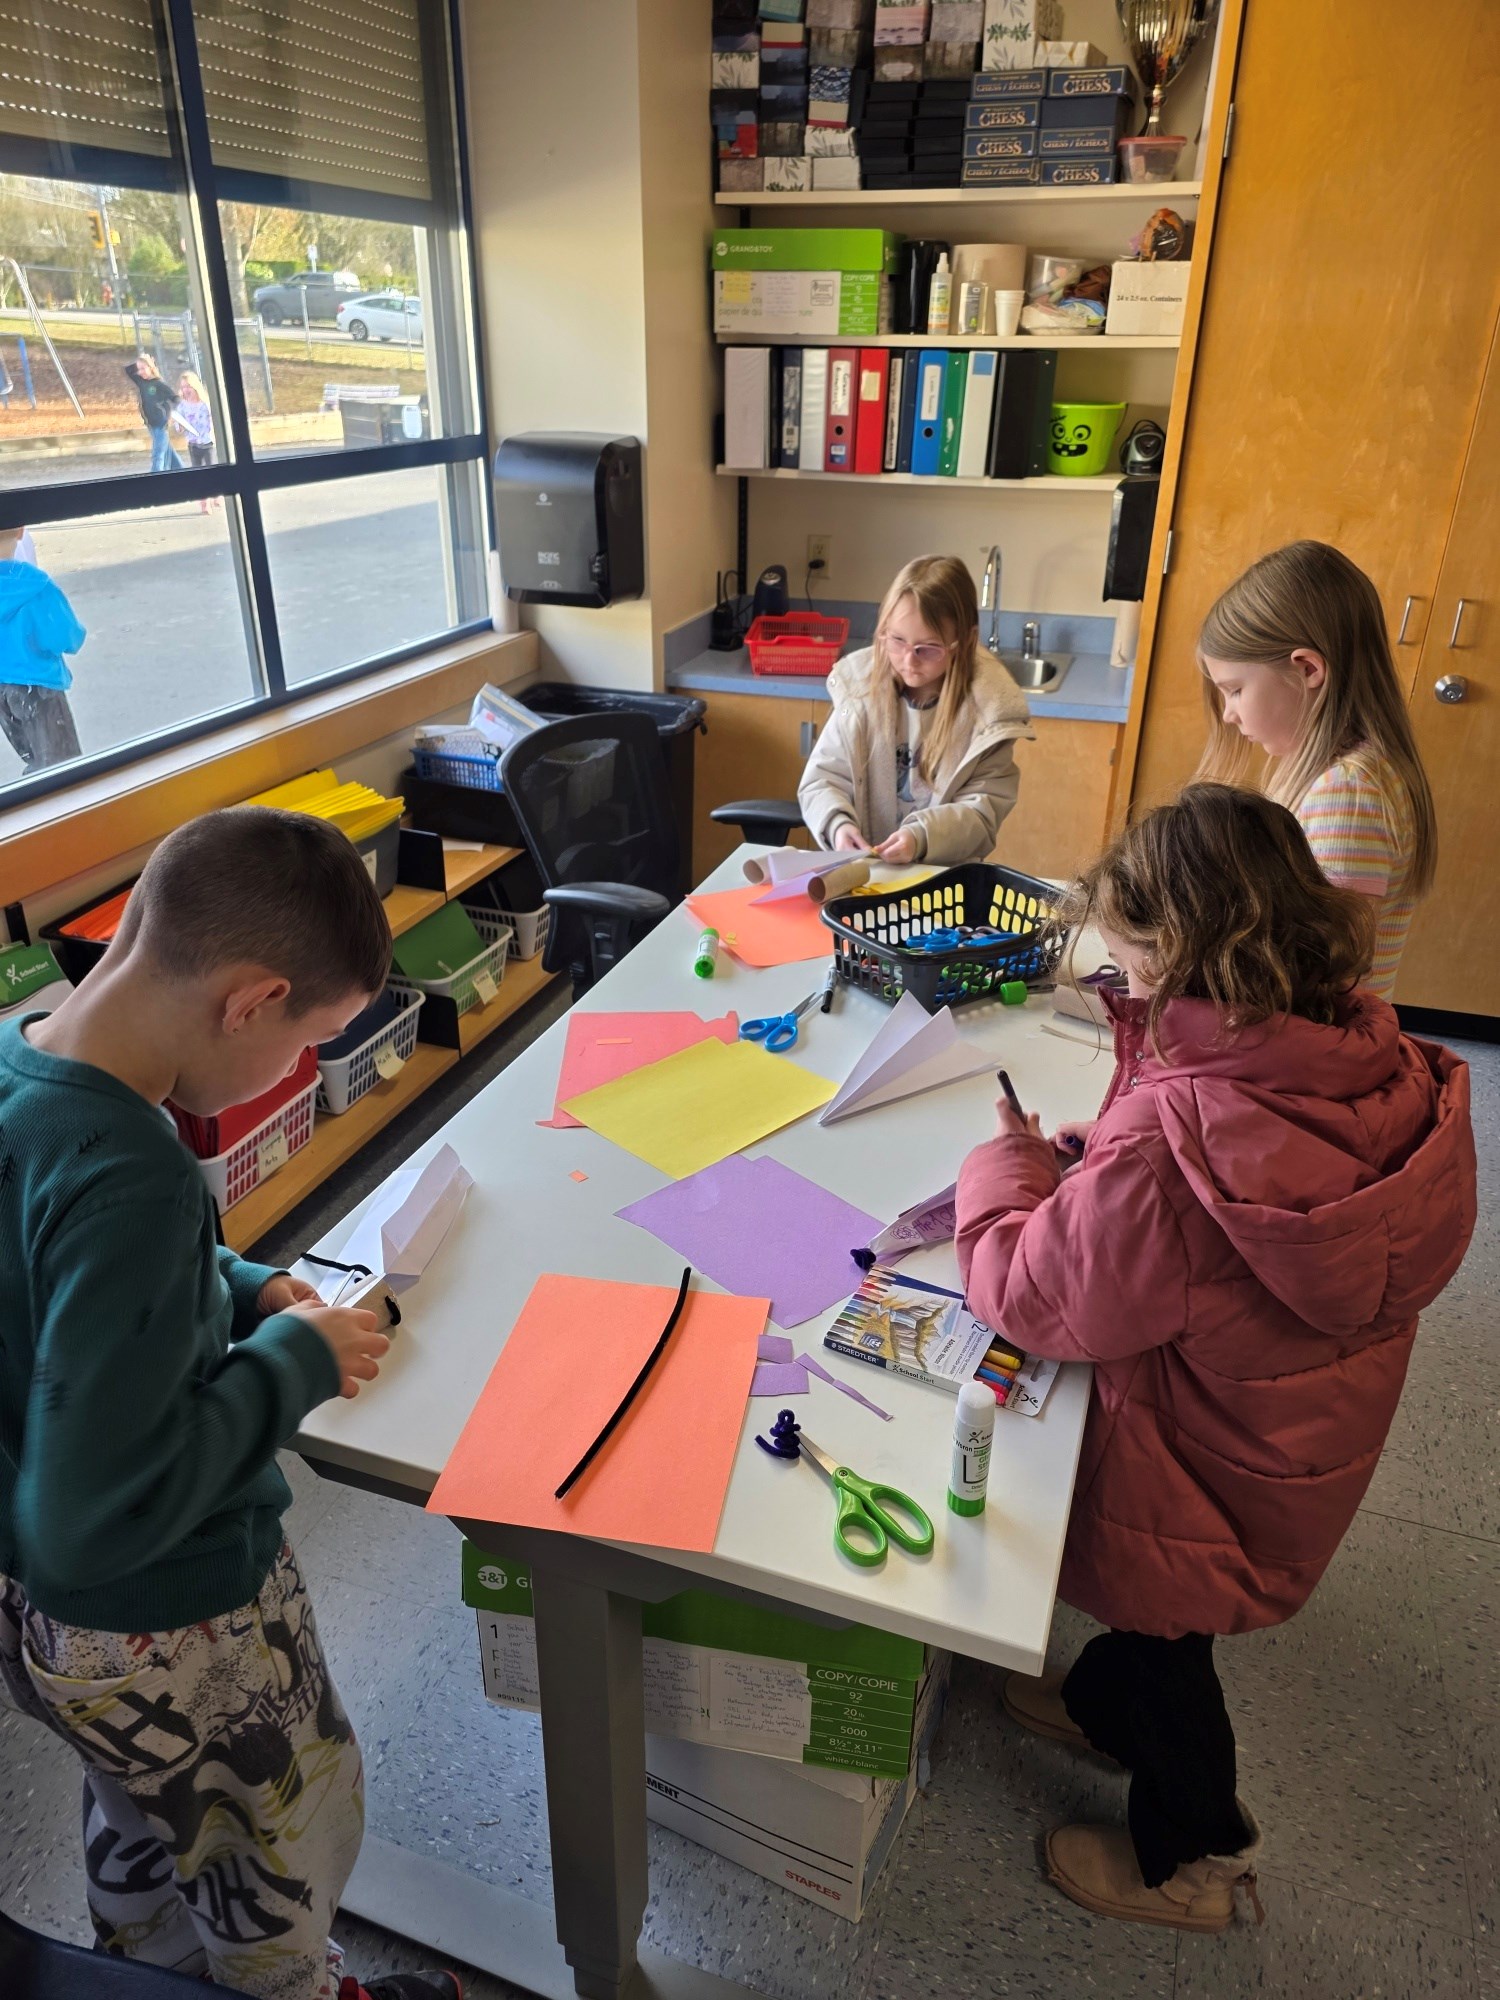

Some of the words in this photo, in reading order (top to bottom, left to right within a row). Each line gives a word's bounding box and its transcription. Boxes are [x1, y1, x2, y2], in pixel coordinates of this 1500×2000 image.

[1063, 78, 1111, 95] CHESS
[979, 111, 1026, 127] CHESS
[976, 140, 1022, 156] CHESS
[1052, 167, 1100, 184] CHESS
[1116, 294, 1124, 302] 24
[1130, 294, 1140, 302] 2.5
[1149, 294, 1183, 303] Containers
[837, 1344, 877, 1364] STAEDTLER
[899, 1367, 919, 1379] School
[919, 1374, 935, 1385] Start
[477, 1569, 507, 1585] G&T
[489, 1624, 498, 1639] 1
[816, 1669, 899, 1692] COPY/COPIE
[849, 1691, 863, 1701] 92
[843, 1707, 858, 1717] 20
[840, 1725, 868, 1738] 5000
[865, 1744, 882, 1753] 11"
[824, 1755, 851, 1765] white
[855, 1758, 879, 1770] blanc
[784, 1870, 842, 1901] STAPLES
